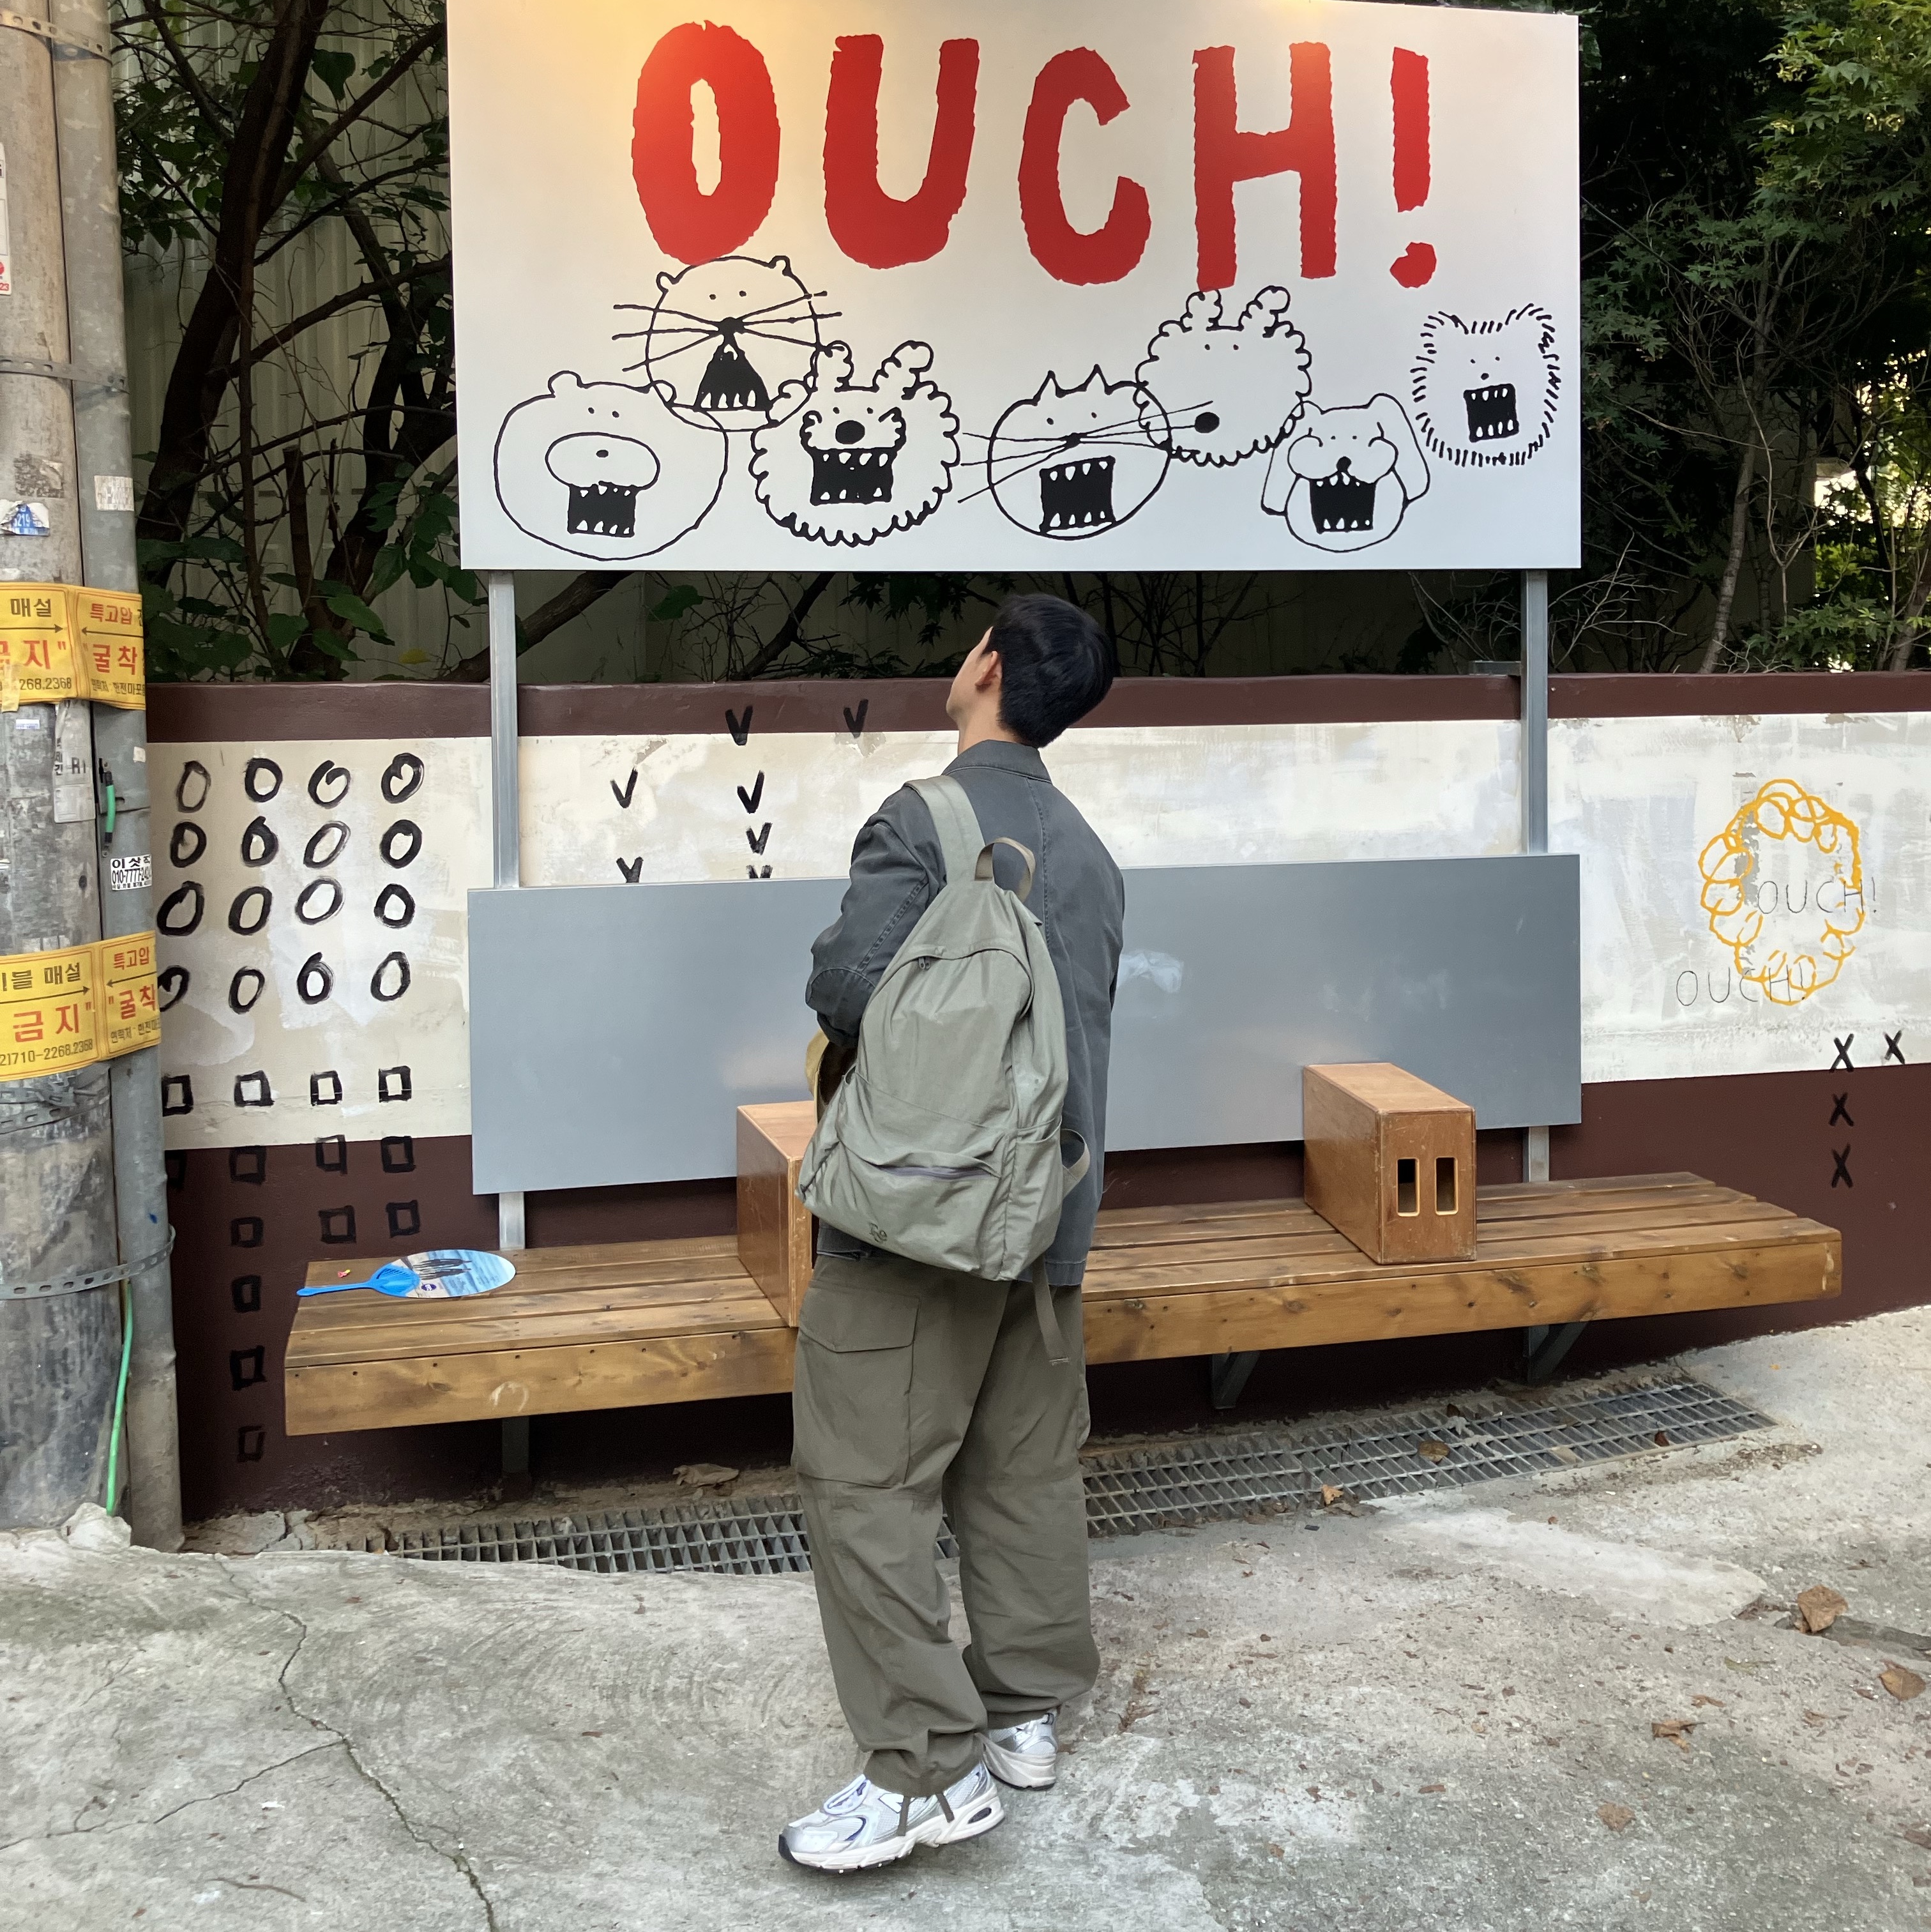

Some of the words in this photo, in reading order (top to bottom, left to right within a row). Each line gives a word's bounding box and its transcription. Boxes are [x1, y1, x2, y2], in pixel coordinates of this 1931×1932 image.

[631, 19, 1437, 293] OUCH!
[10, 598, 52, 618] 매설
[90, 603, 133, 625] 특고압
[1757, 877, 1877, 914] OUCH!
[44, 962, 80, 985] 매설
[1676, 964, 1806, 1006] OUCH!
